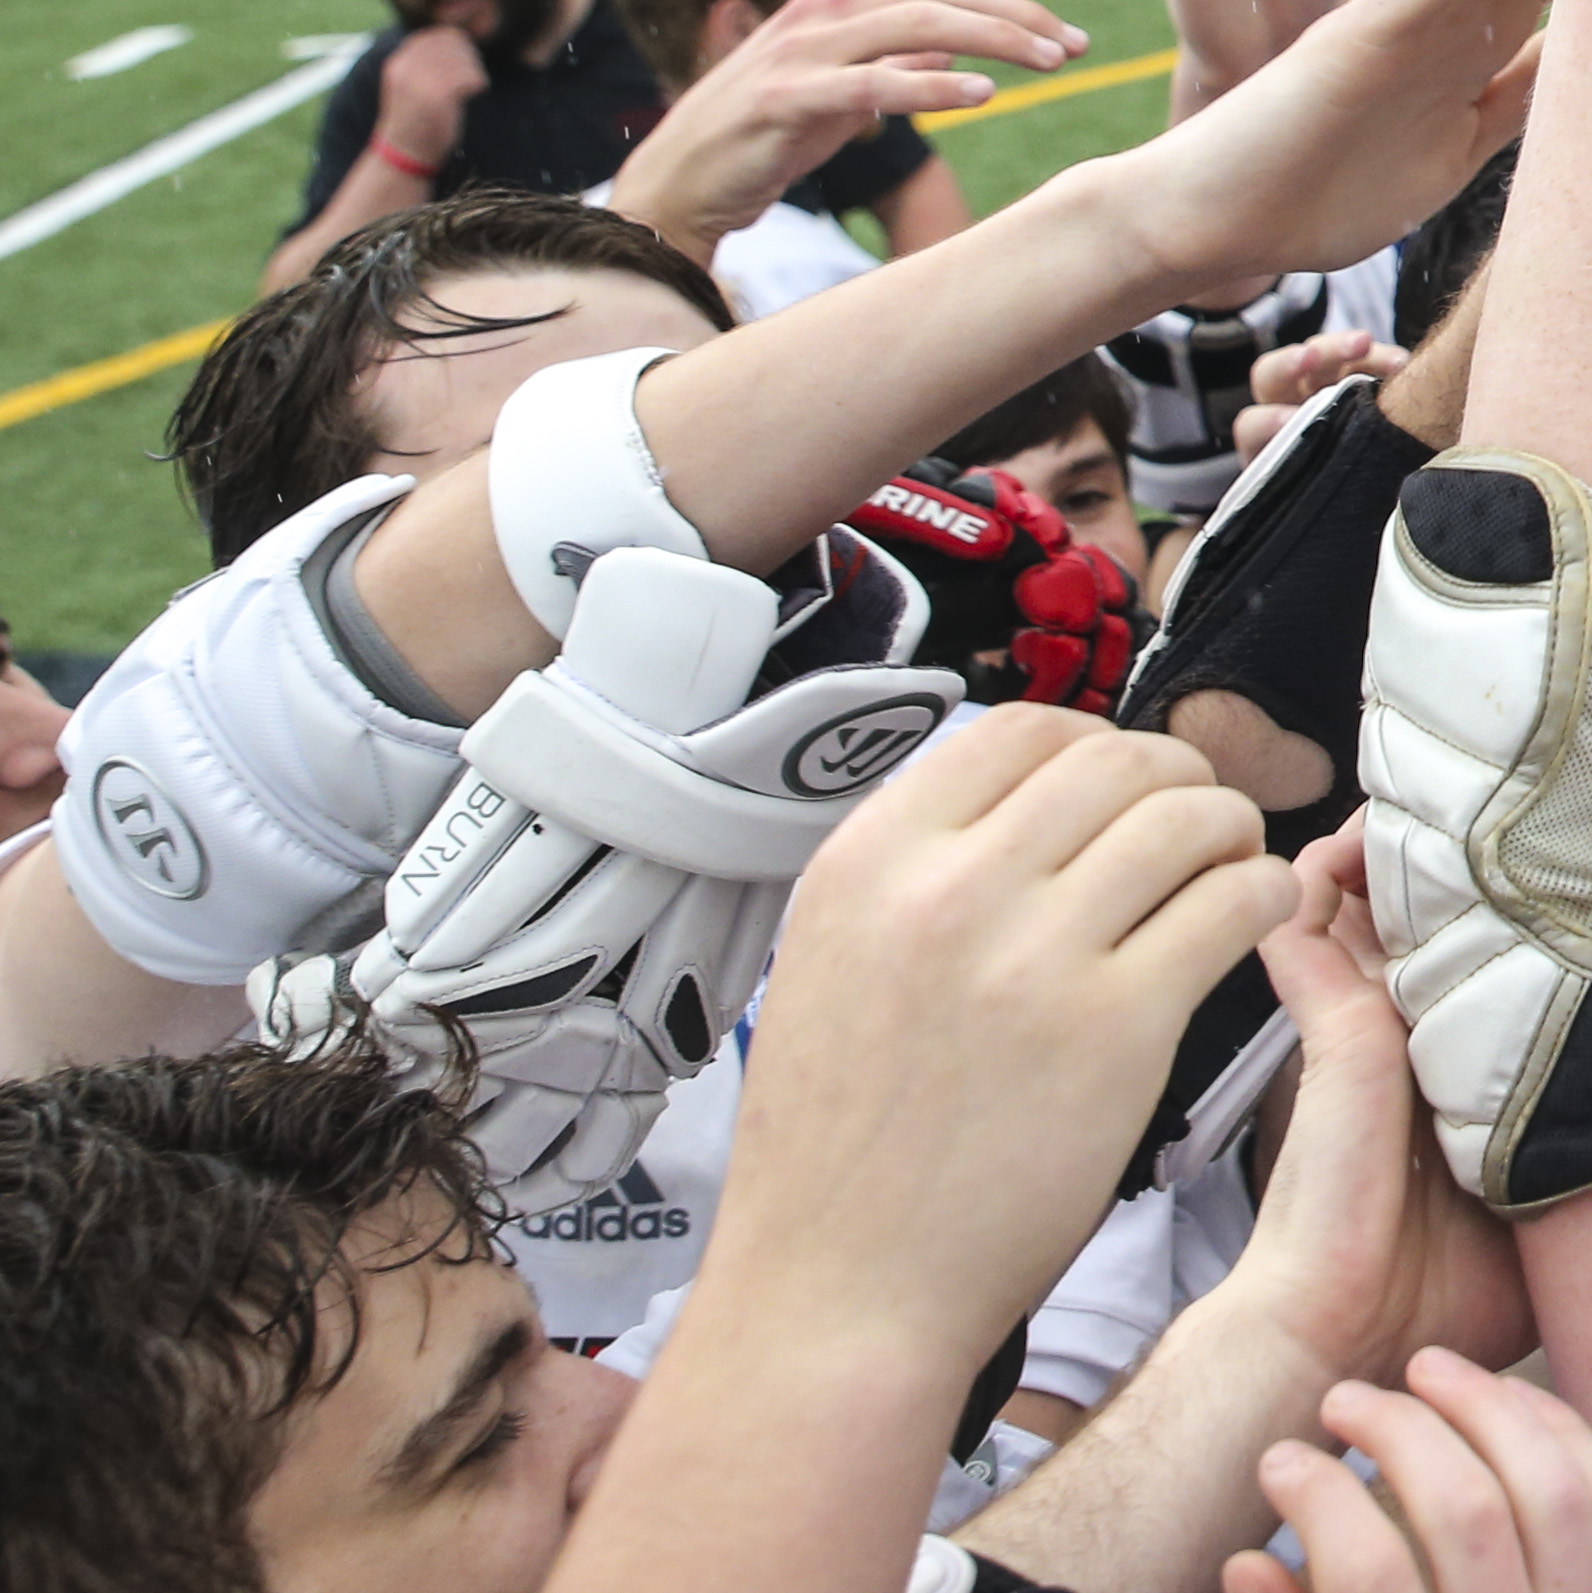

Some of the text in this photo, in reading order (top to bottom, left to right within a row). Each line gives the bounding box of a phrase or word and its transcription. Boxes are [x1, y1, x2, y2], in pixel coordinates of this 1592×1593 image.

[868, 484, 989, 544] RINE
[400, 781, 506, 898] BURN
[521, 1204, 690, 1242] adidas
